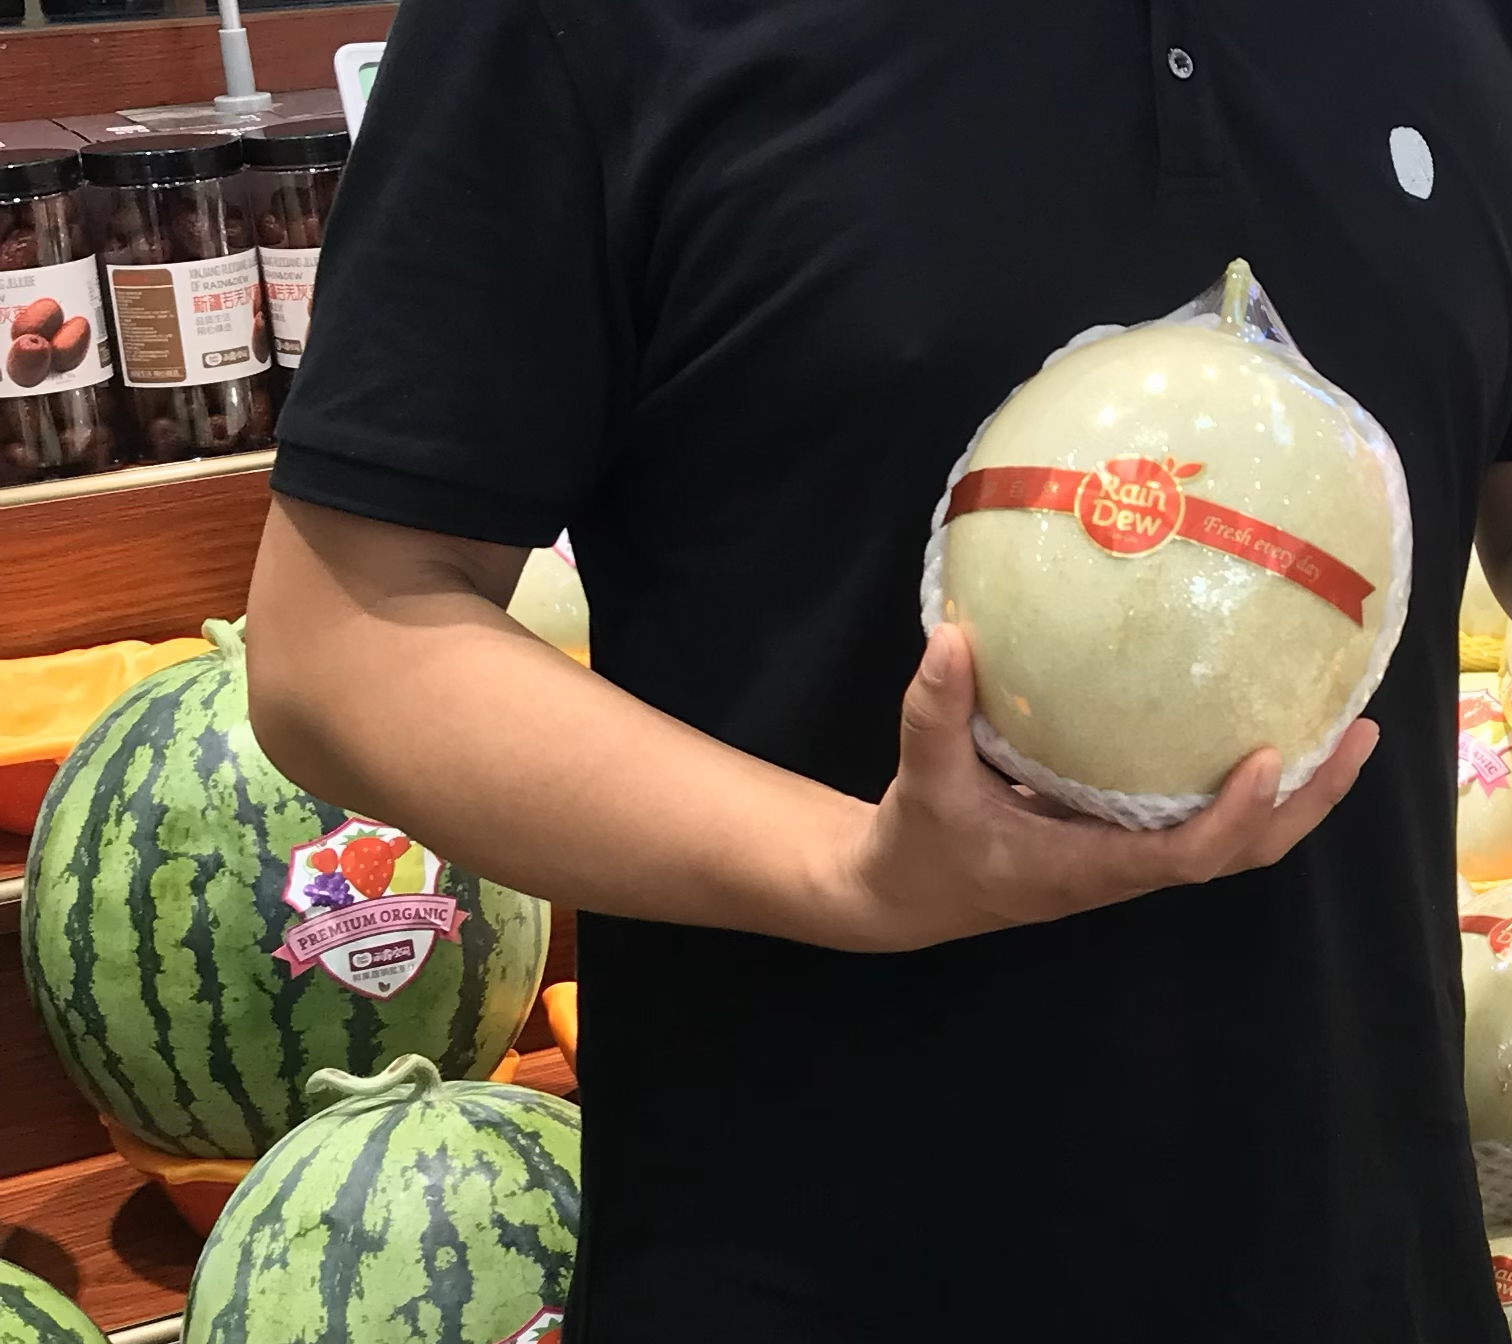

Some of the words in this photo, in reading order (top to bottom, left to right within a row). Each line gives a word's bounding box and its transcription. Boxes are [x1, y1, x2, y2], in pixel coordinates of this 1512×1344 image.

[1101, 478, 1168, 513] Rain
[1092, 498, 1163, 538] Dew
[1203, 515, 1253, 548] Fresh
[1253, 537, 1303, 569] every
[1300, 554, 1323, 584] day
[296, 912, 379, 951] PREMIUM
[381, 906, 449, 926] ORGANIC
